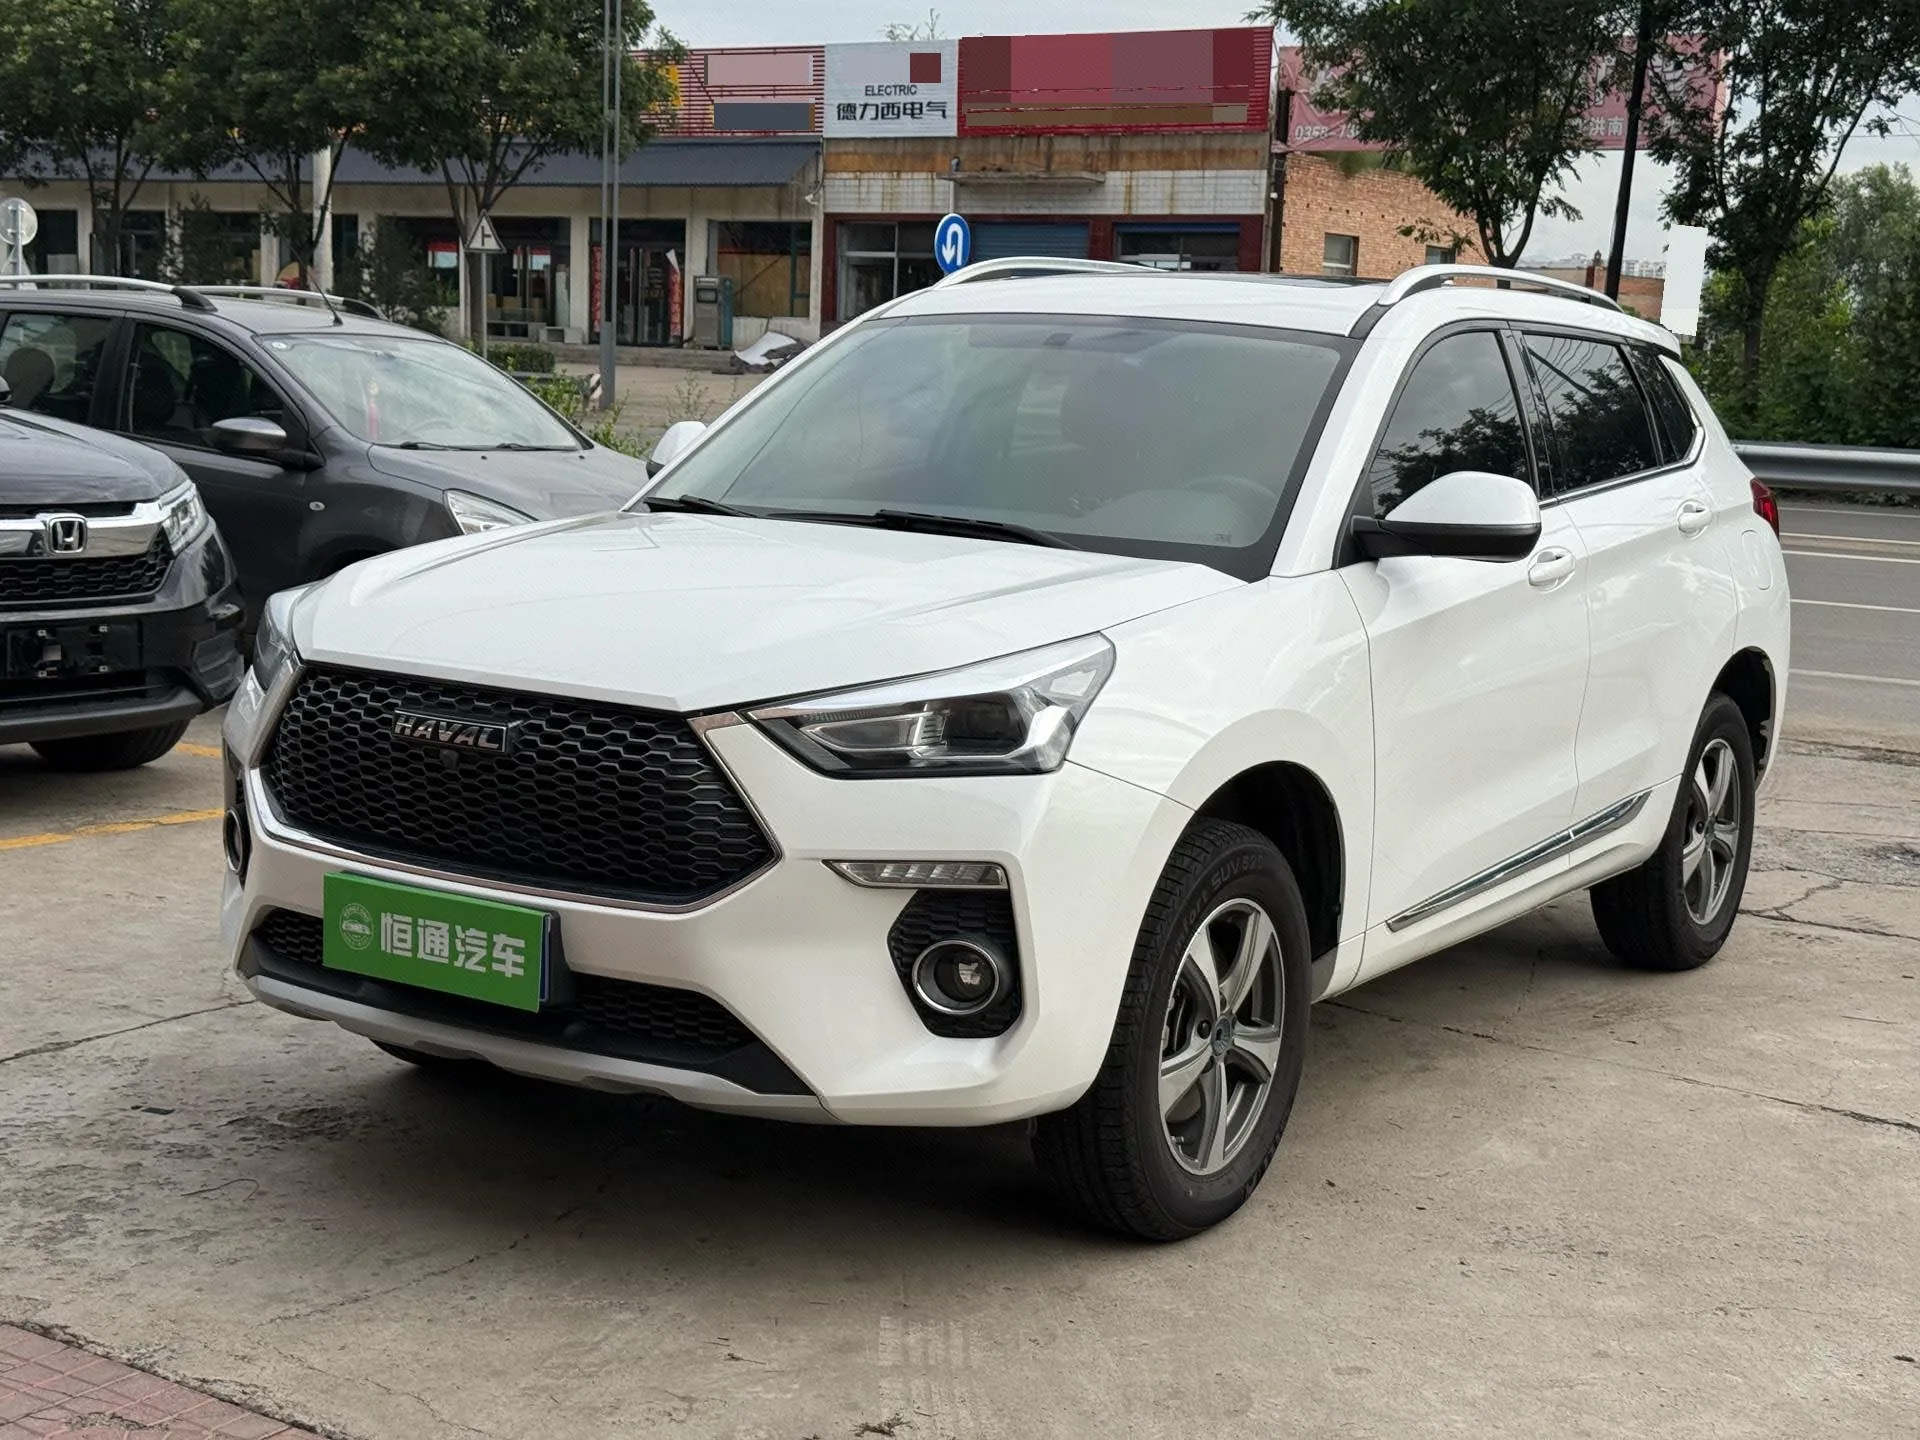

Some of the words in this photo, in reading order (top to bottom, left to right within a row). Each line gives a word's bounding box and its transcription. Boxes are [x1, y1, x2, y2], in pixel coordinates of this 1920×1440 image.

[865, 84, 918, 97] ELECTRIC
[836, 101, 948, 121] 德力西电气
[394, 714, 500, 749] HAVAL
[380, 911, 525, 978] 恒通汽车
